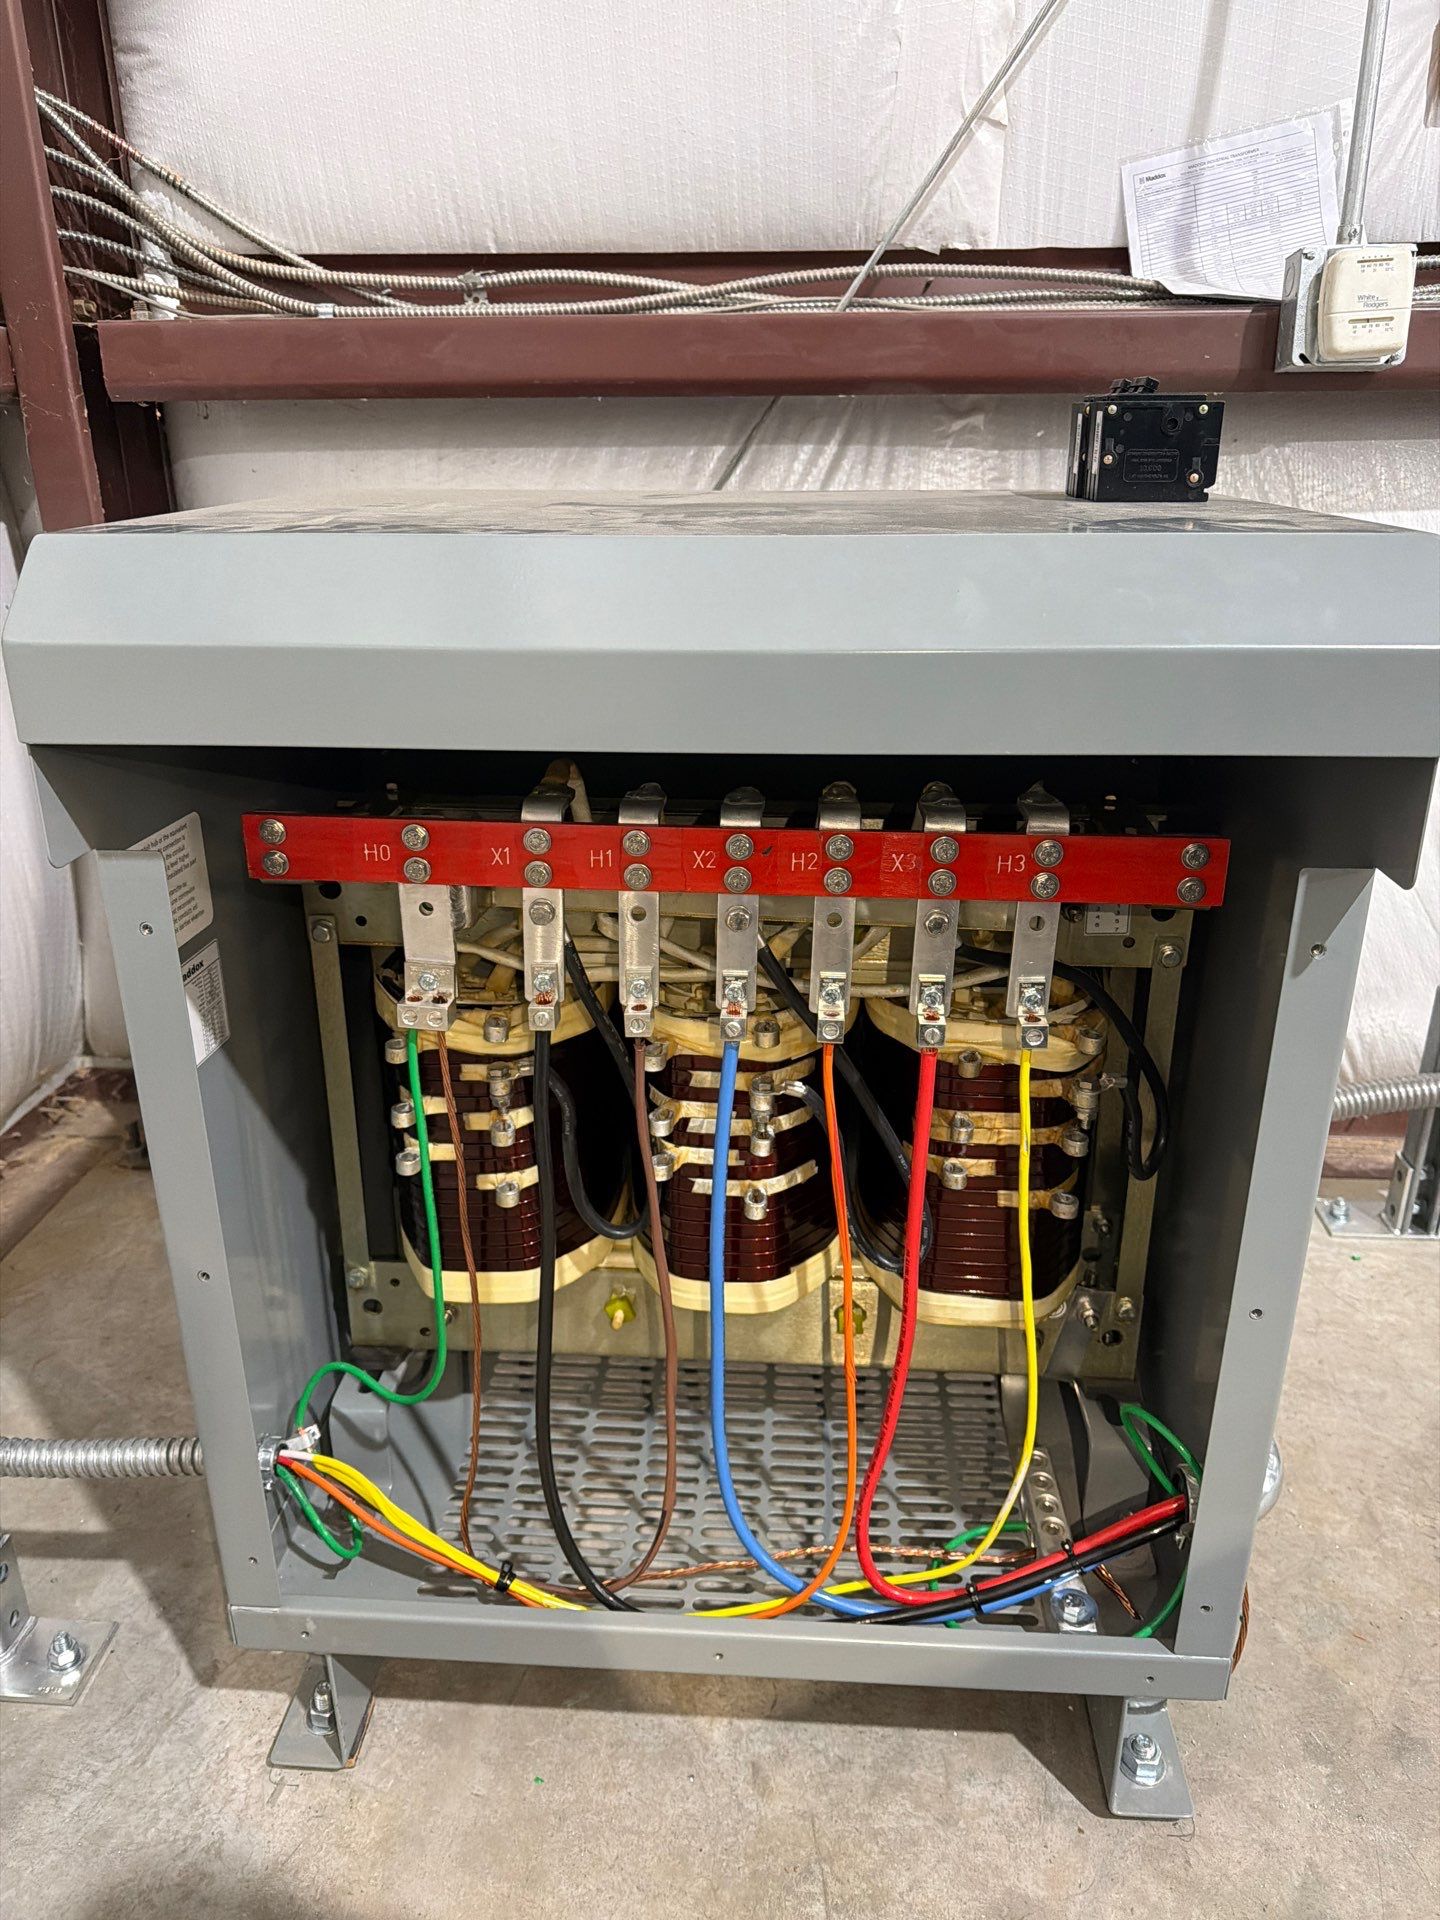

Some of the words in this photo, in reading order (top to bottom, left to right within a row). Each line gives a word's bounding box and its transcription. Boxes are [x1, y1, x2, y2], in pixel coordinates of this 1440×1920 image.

[1146, 174, 1166, 182] Maddox
[364, 844, 390, 861] H0
[491, 847, 510, 866] X1
[590, 850, 613, 868] H1
[692, 850, 717, 869] X2
[792, 853, 818, 871] H2
[892, 853, 917, 872] X3
[997, 855, 1026, 873] H3
[183, 960, 204, 982] addox
